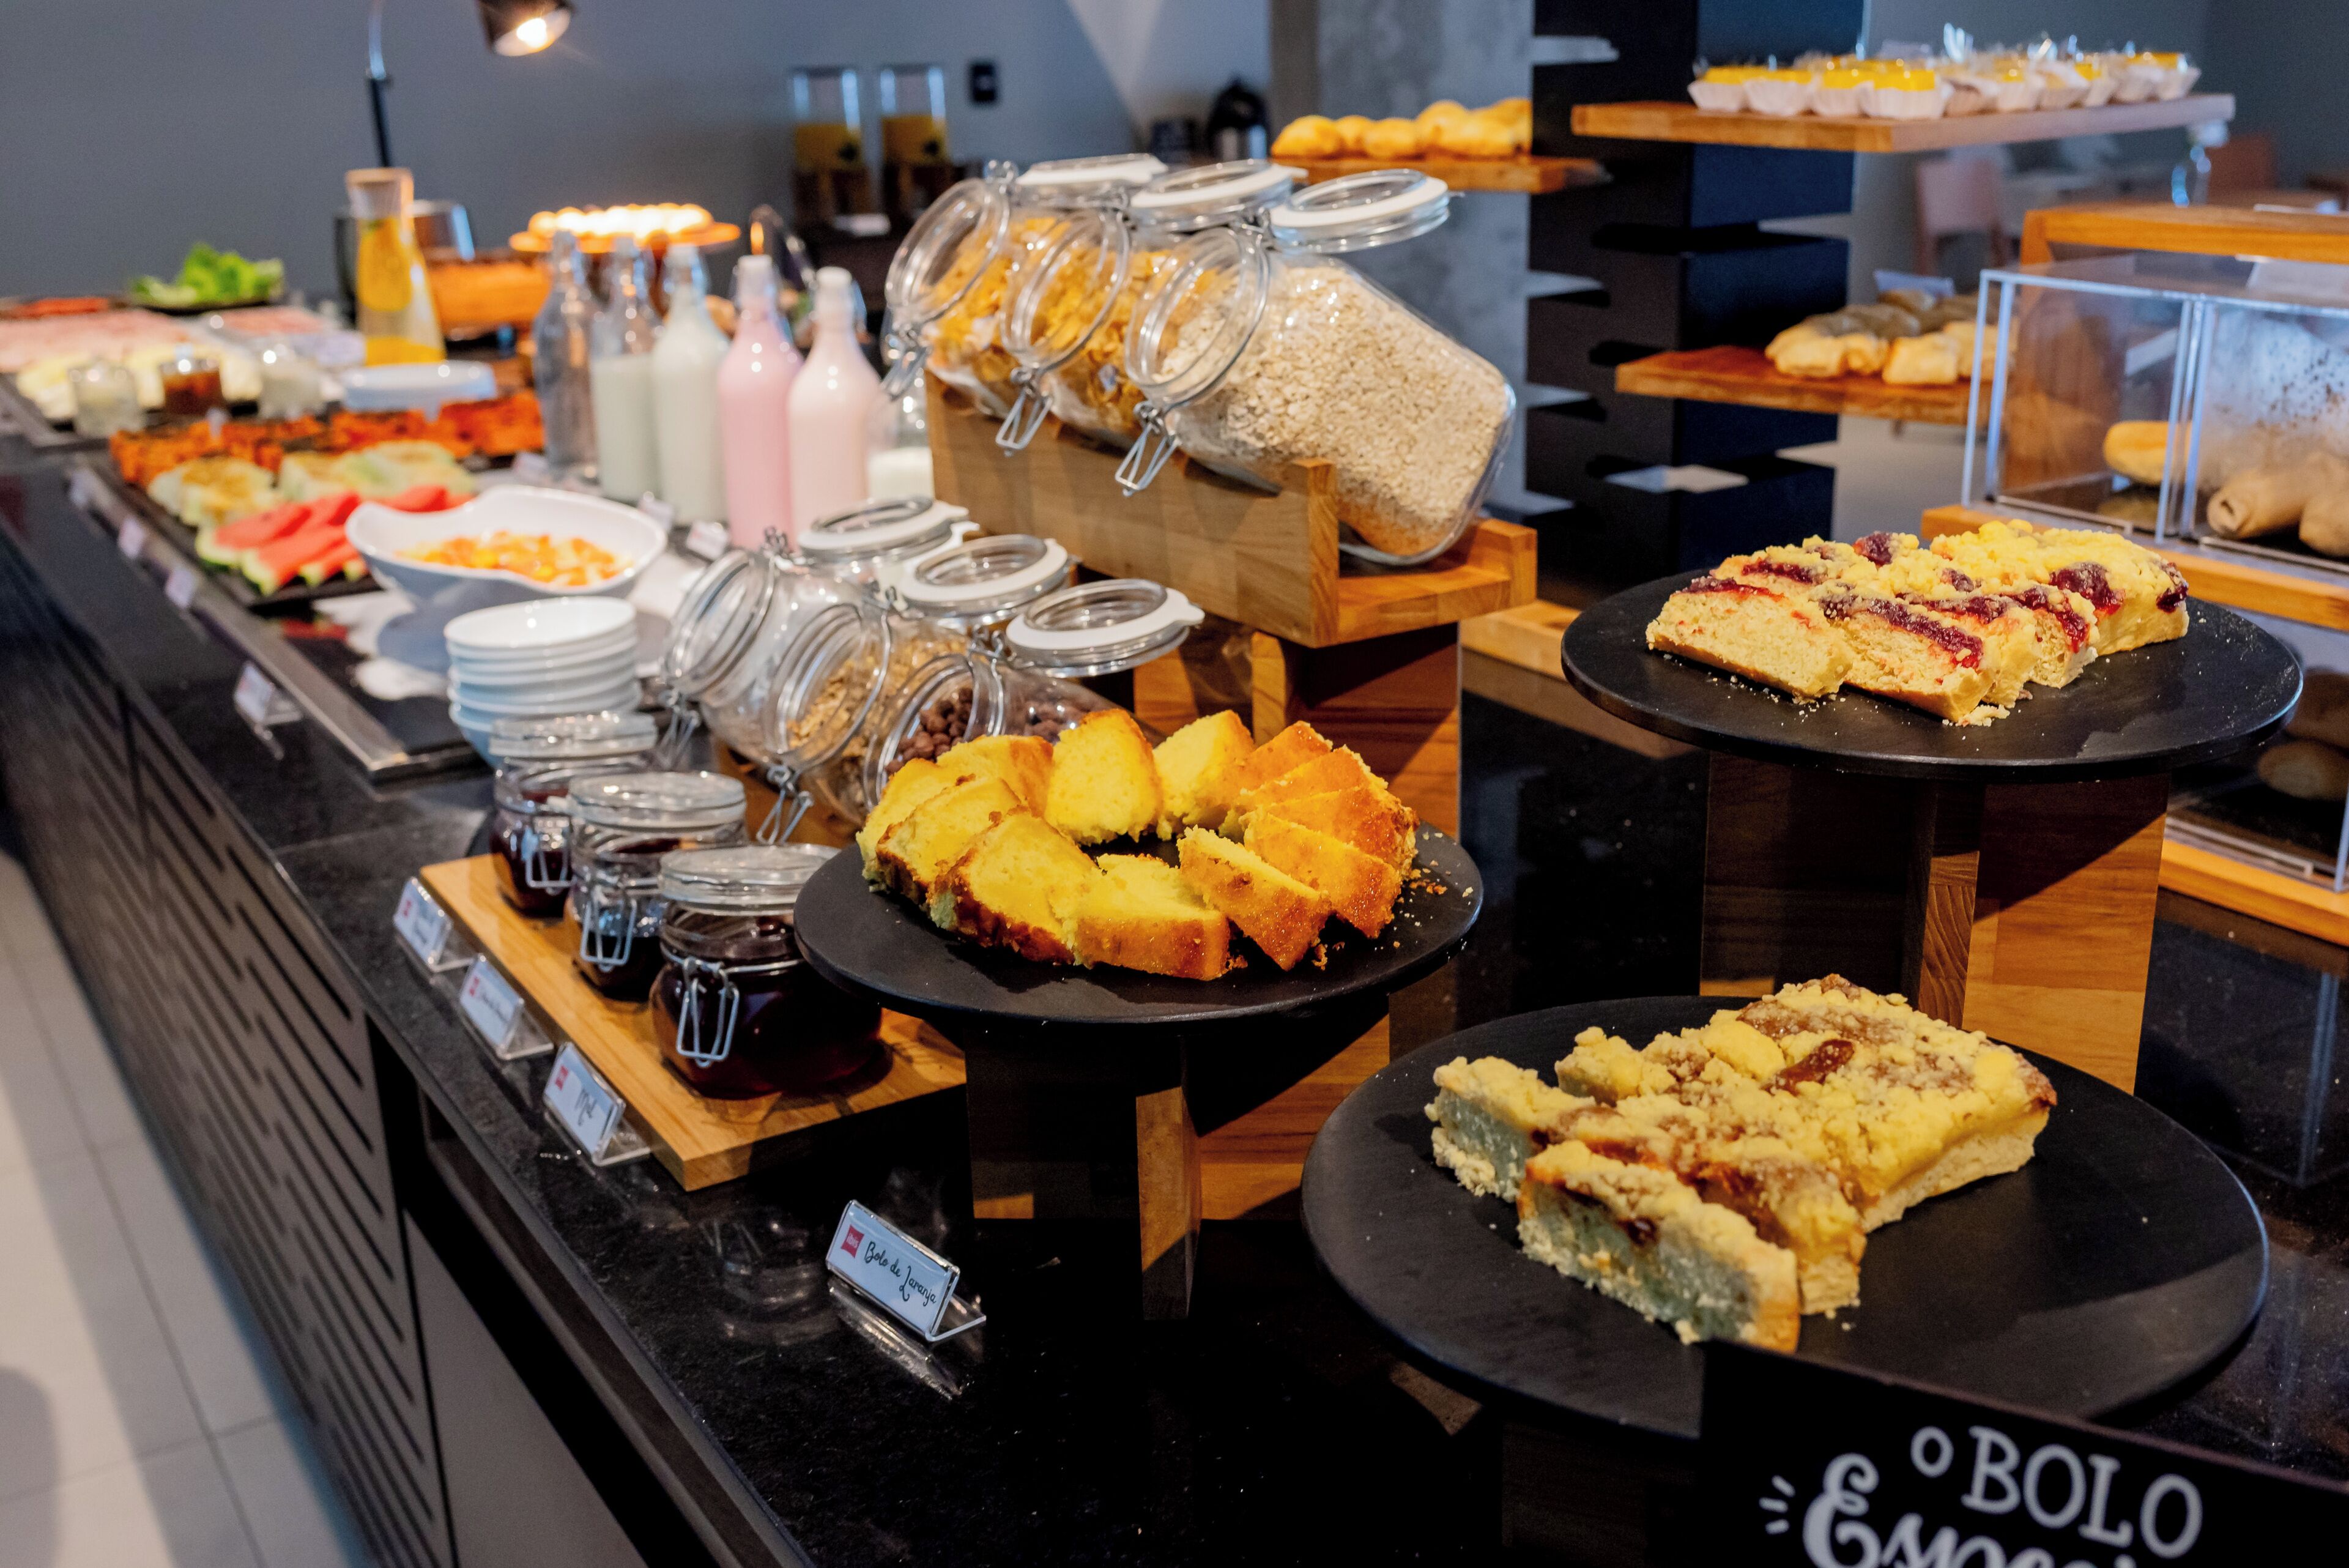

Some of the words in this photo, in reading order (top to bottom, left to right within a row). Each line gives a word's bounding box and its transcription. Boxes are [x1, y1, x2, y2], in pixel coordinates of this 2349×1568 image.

[864, 1241, 889, 1268] Bolo
[890, 1258, 901, 1278] de
[899, 1265, 937, 1307] Laranja
[1961, 1425, 2203, 1559] BOLO
